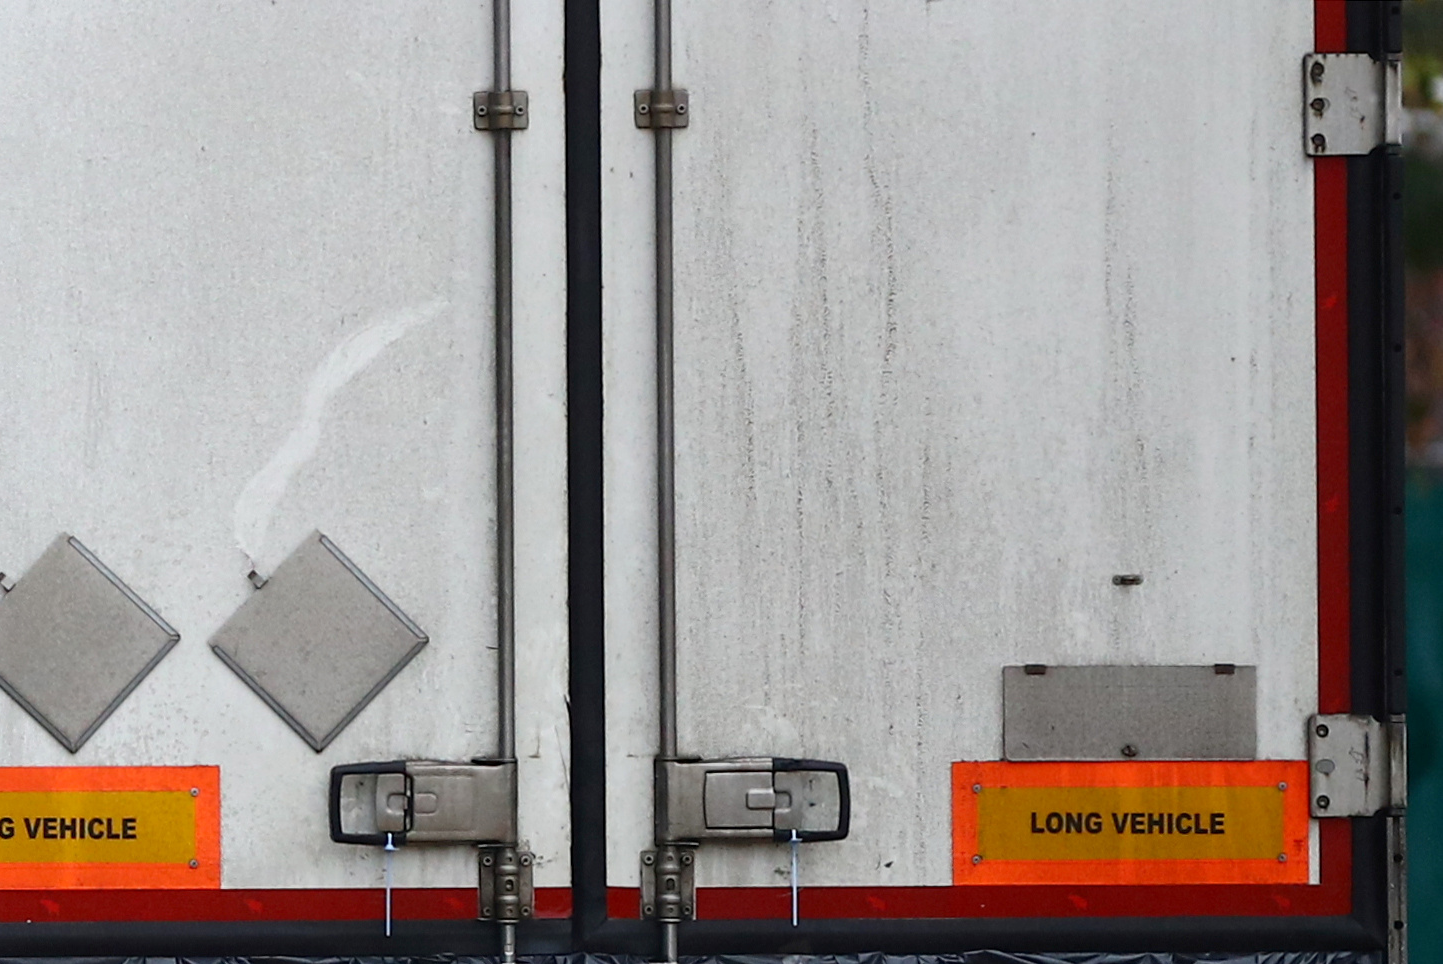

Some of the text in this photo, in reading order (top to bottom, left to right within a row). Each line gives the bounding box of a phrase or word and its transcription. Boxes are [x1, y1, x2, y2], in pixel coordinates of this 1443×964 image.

[24, 818, 137, 839] VEHICLE
[1031, 812, 1225, 834] LONG VEHICLE
